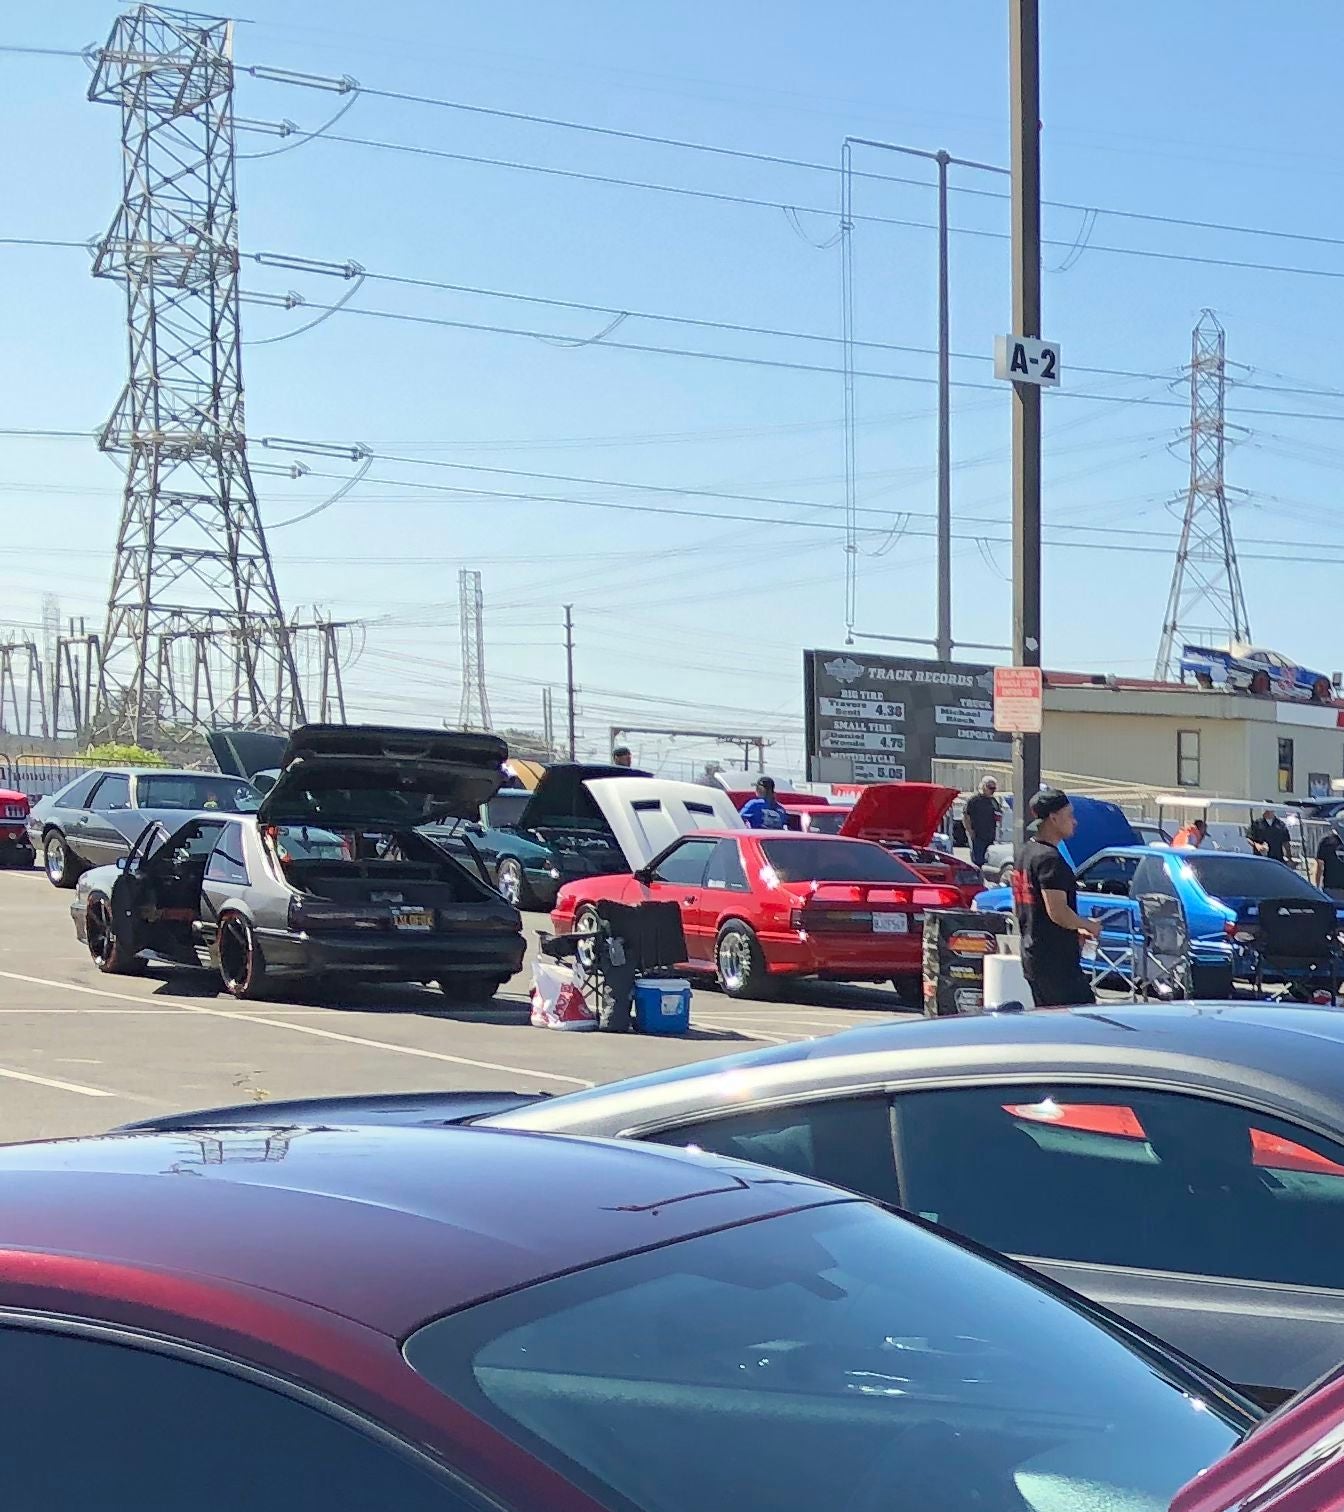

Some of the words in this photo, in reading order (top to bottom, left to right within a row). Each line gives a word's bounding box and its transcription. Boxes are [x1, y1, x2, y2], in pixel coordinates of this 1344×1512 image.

[1010, 343, 1055, 379] A-2
[868, 668, 912, 682] TRACK
[915, 671, 973, 687] RECORDS
[841, 689, 859, 699] BIG
[860, 691, 884, 701] TIRE
[960, 698, 992, 709] TRUCK
[875, 703, 902, 718] 4.38
[834, 721, 867, 731] SMALL
[868, 723, 892, 733] TIRE
[957, 729, 995, 741] IMPORT
[880, 737, 903, 749] 4.75
